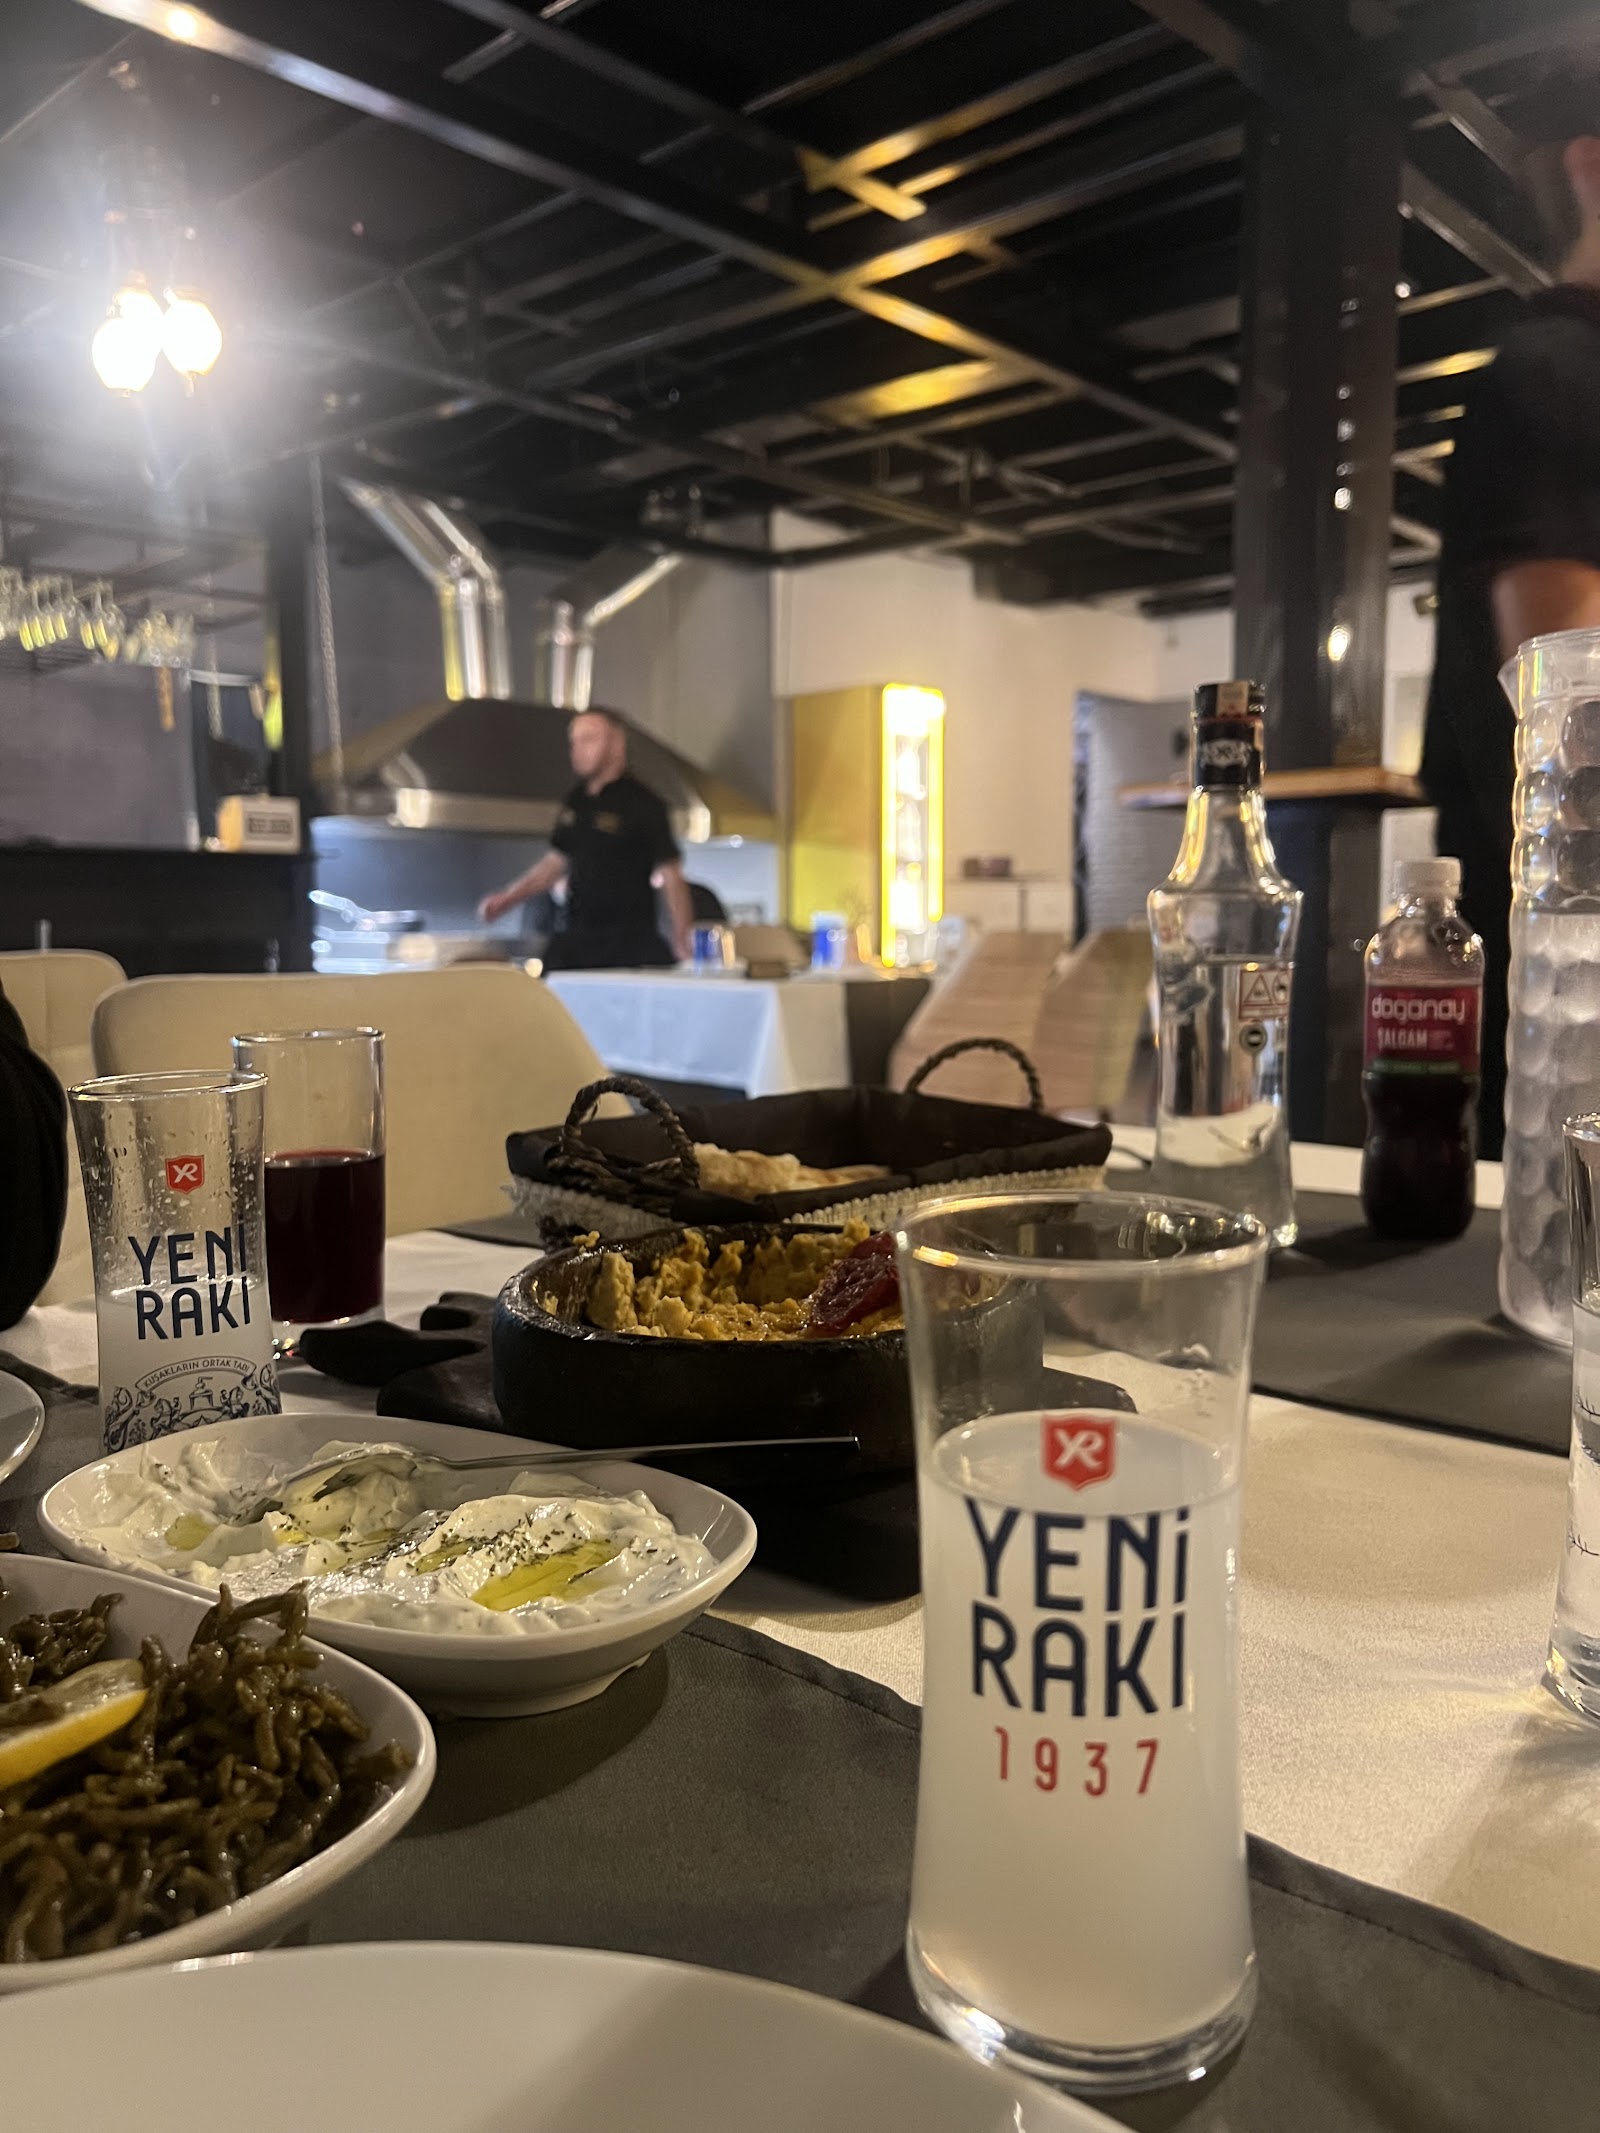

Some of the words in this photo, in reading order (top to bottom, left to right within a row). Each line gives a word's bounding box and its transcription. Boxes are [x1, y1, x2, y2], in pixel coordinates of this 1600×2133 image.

[135, 1275, 251, 1340] RAKI
[201, 1359, 232, 1369] ORTAK
[970, 1601, 1187, 1718] RAKI
[994, 1725, 1160, 1797] 1937
